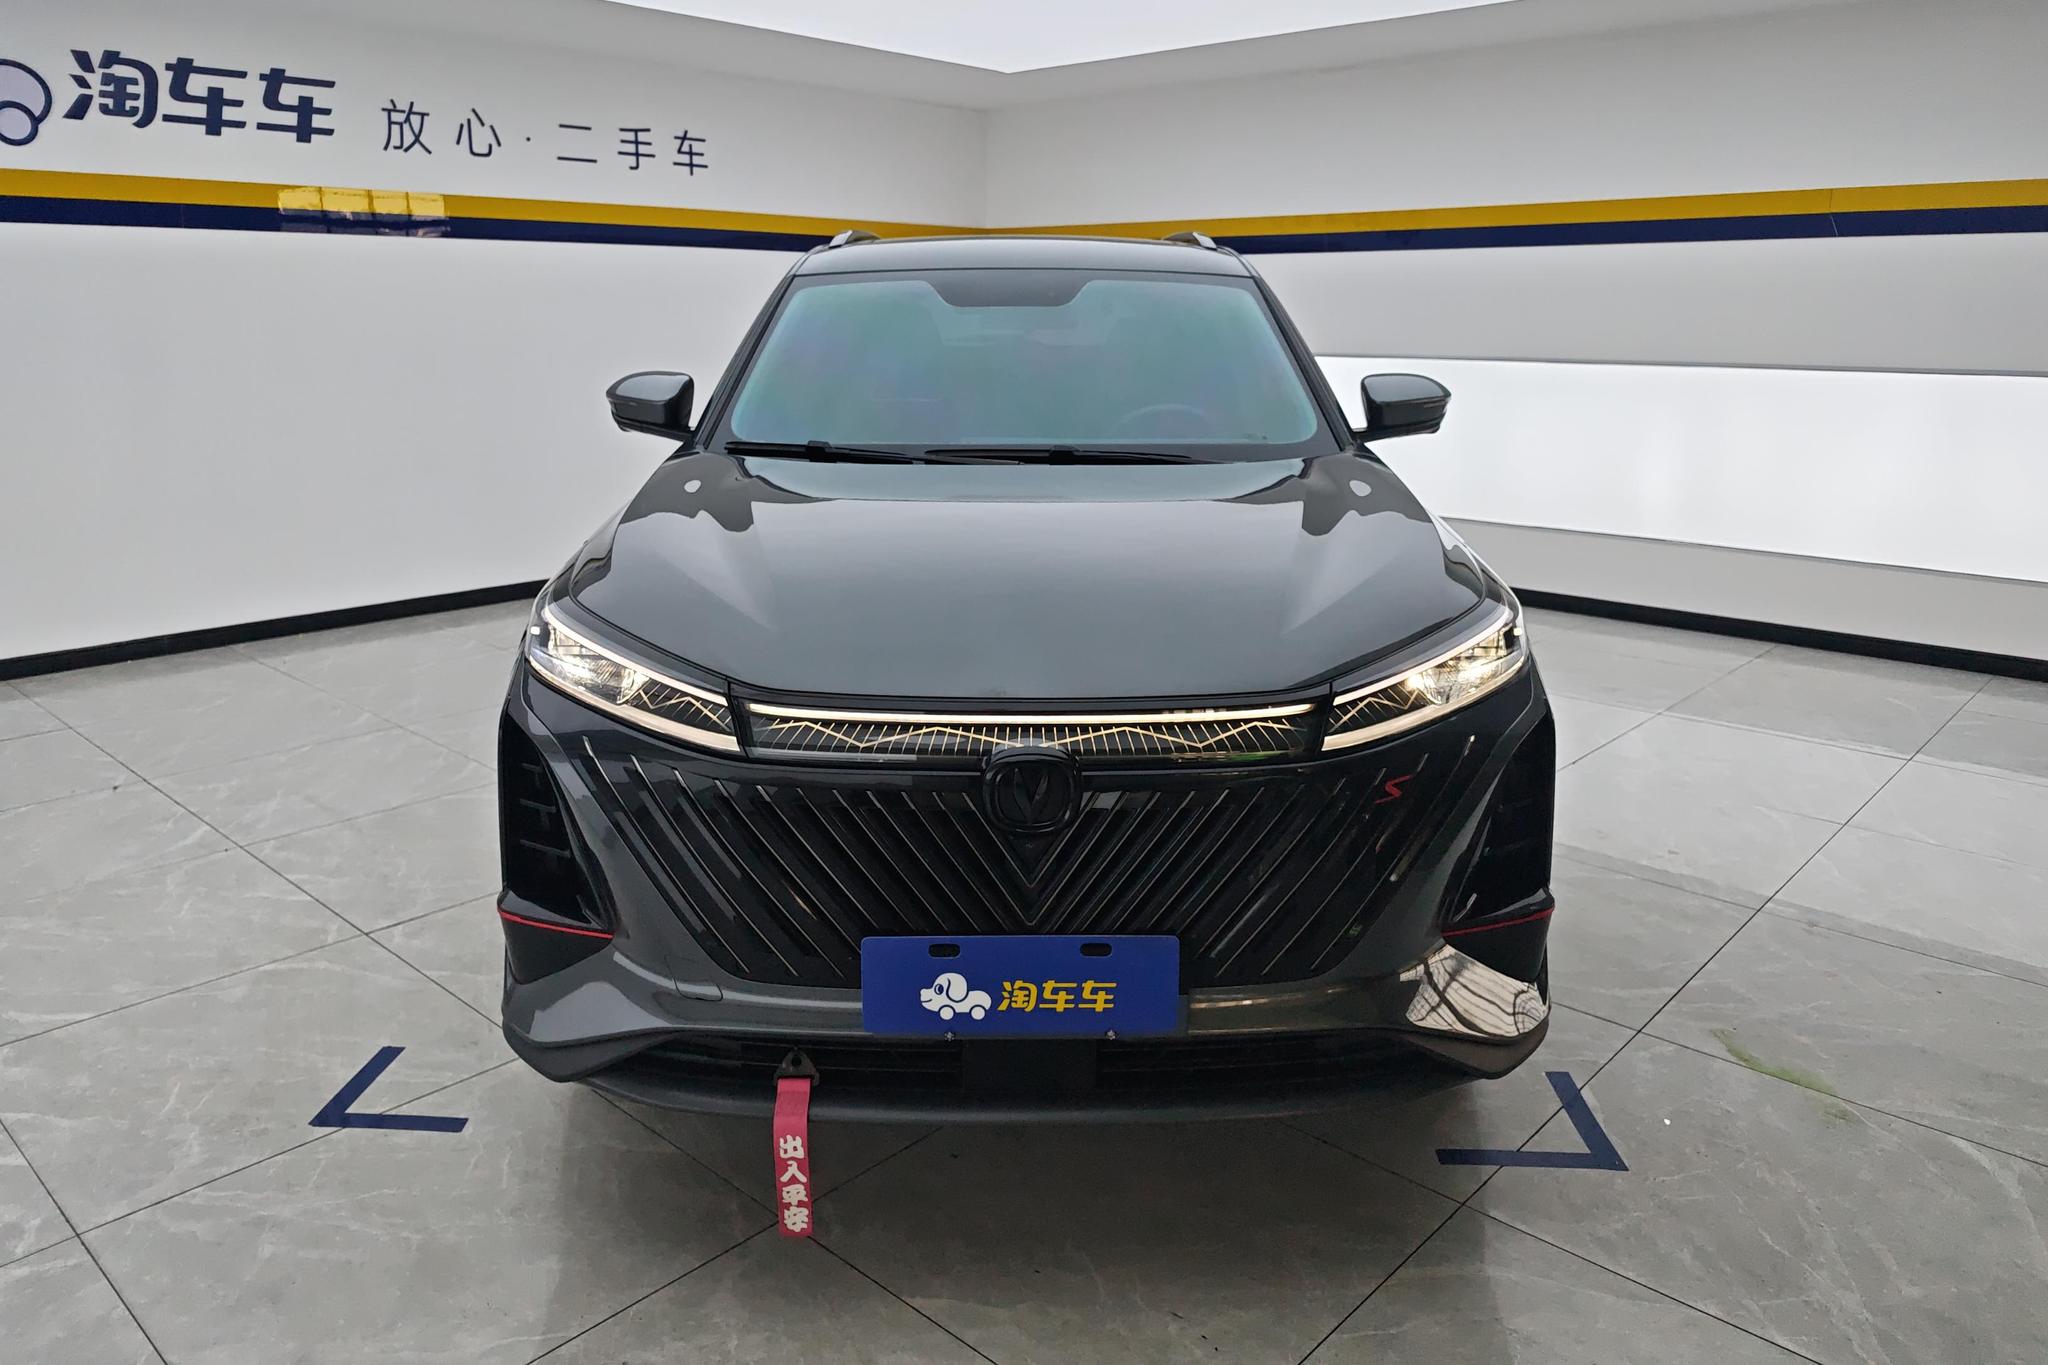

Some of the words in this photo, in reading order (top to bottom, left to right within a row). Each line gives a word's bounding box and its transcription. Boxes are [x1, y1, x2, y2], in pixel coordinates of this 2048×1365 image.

[62, 49, 336, 144] 淘车车
[997, 980, 1117, 1013] 淘车车
[779, 1134, 809, 1233] 出入平安
